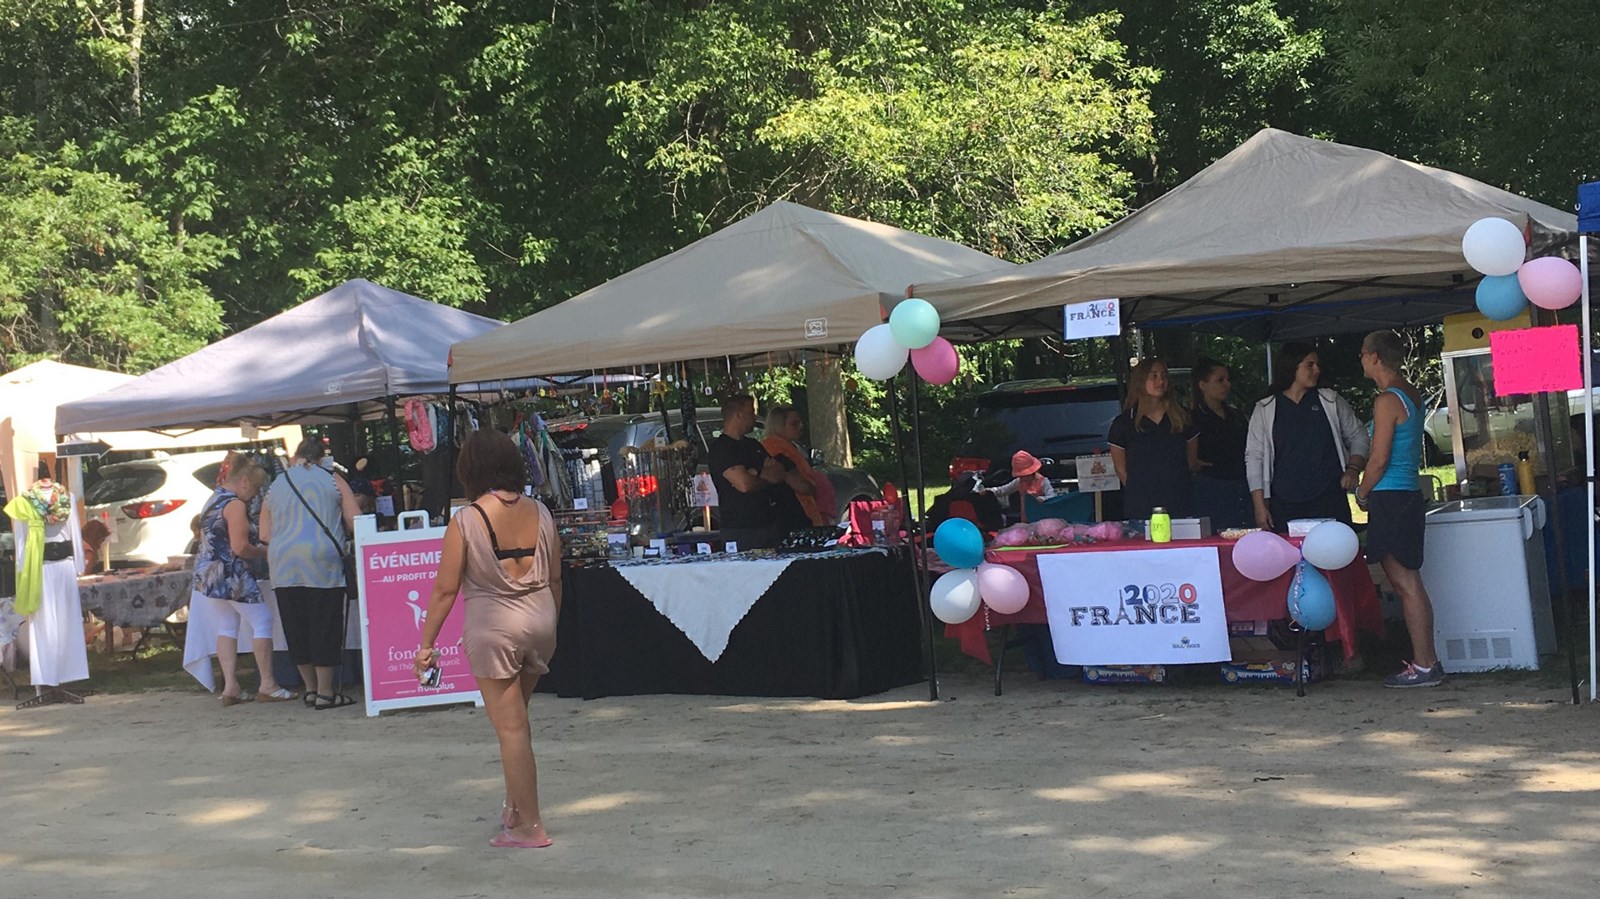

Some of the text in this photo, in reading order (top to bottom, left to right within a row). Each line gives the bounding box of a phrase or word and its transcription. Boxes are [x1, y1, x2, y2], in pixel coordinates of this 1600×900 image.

[1070, 308, 1115, 321] FRANCE
[382, 574, 395, 583] AU
[396, 571, 427, 582] PROFIT
[1124, 582, 1197, 605] 2020
[1069, 604, 1200, 626] FRANCE
[388, 643, 459, 661] fondion
